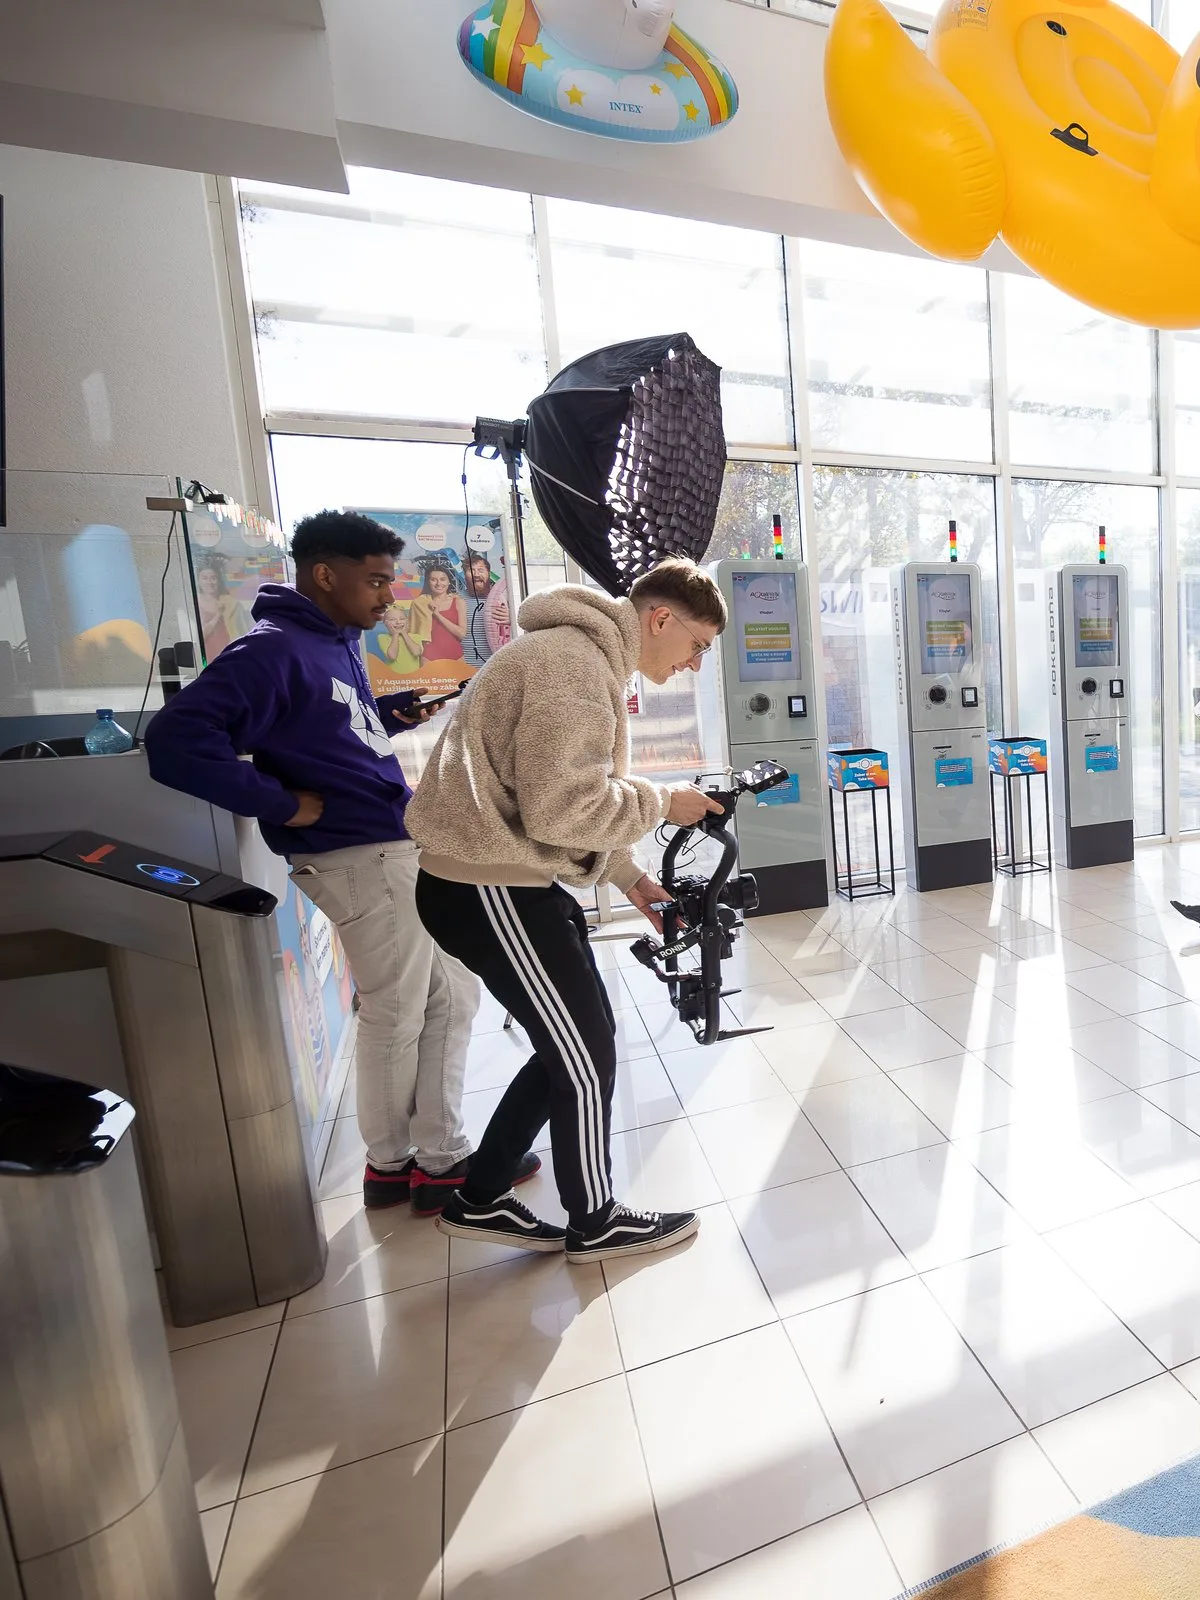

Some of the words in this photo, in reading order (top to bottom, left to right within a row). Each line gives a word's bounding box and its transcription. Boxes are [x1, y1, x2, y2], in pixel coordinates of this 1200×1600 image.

[609, 101, 642, 114] INTEX
[384, 678, 431, 686] Aquaparku
[659, 942, 687, 958] RONIN
